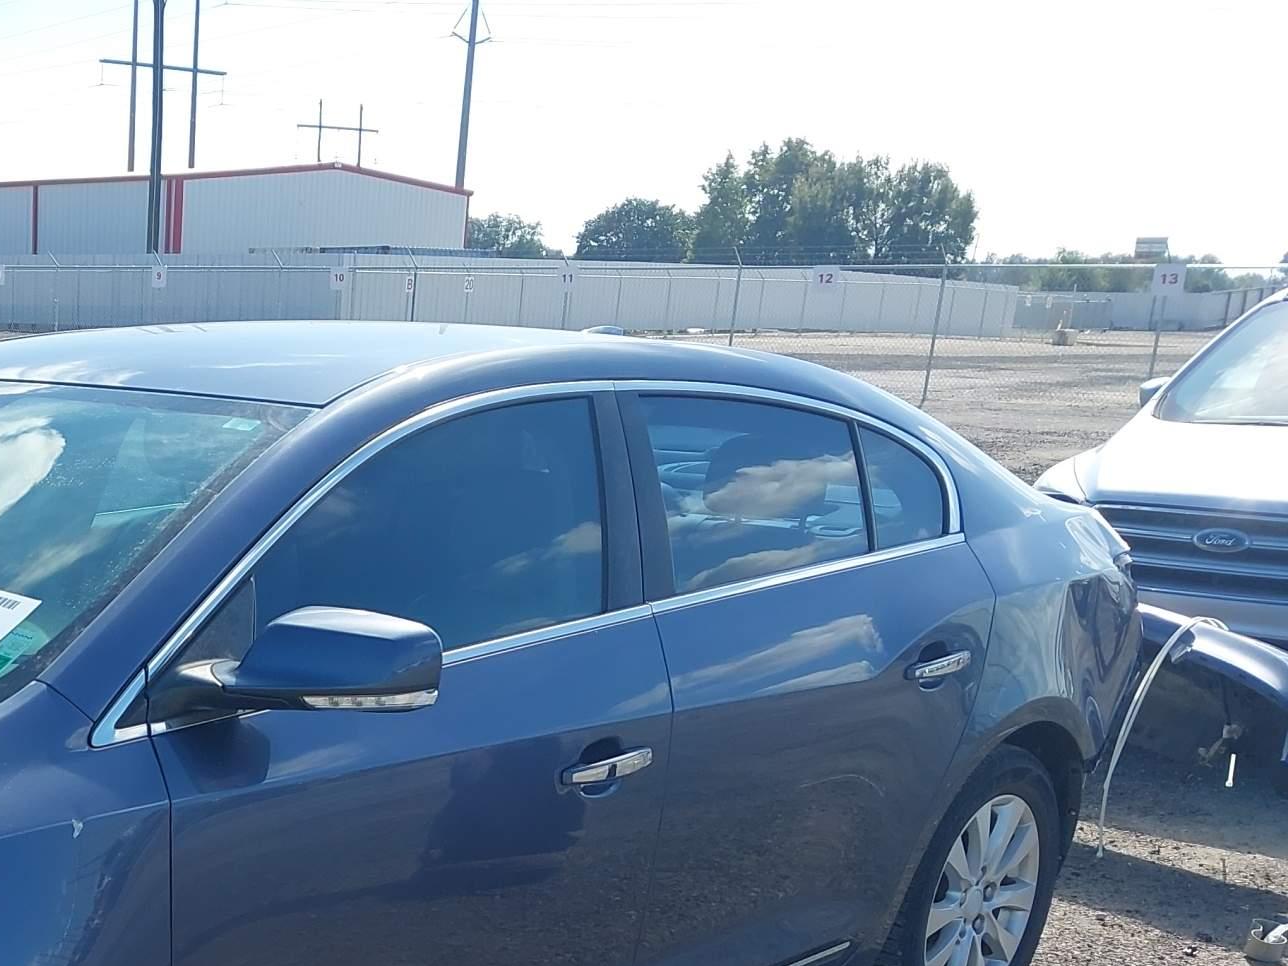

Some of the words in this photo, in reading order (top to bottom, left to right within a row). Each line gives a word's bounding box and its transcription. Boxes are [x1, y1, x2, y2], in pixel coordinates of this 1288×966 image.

[156, 272, 162, 280] 9
[334, 273, 345, 282] 10
[562, 274, 573, 283] 11
[818, 273, 833, 284] 12
[1160, 273, 1179, 285] 13
[465, 279, 474, 290] 20
[1205, 534, 1236, 546] Ford
